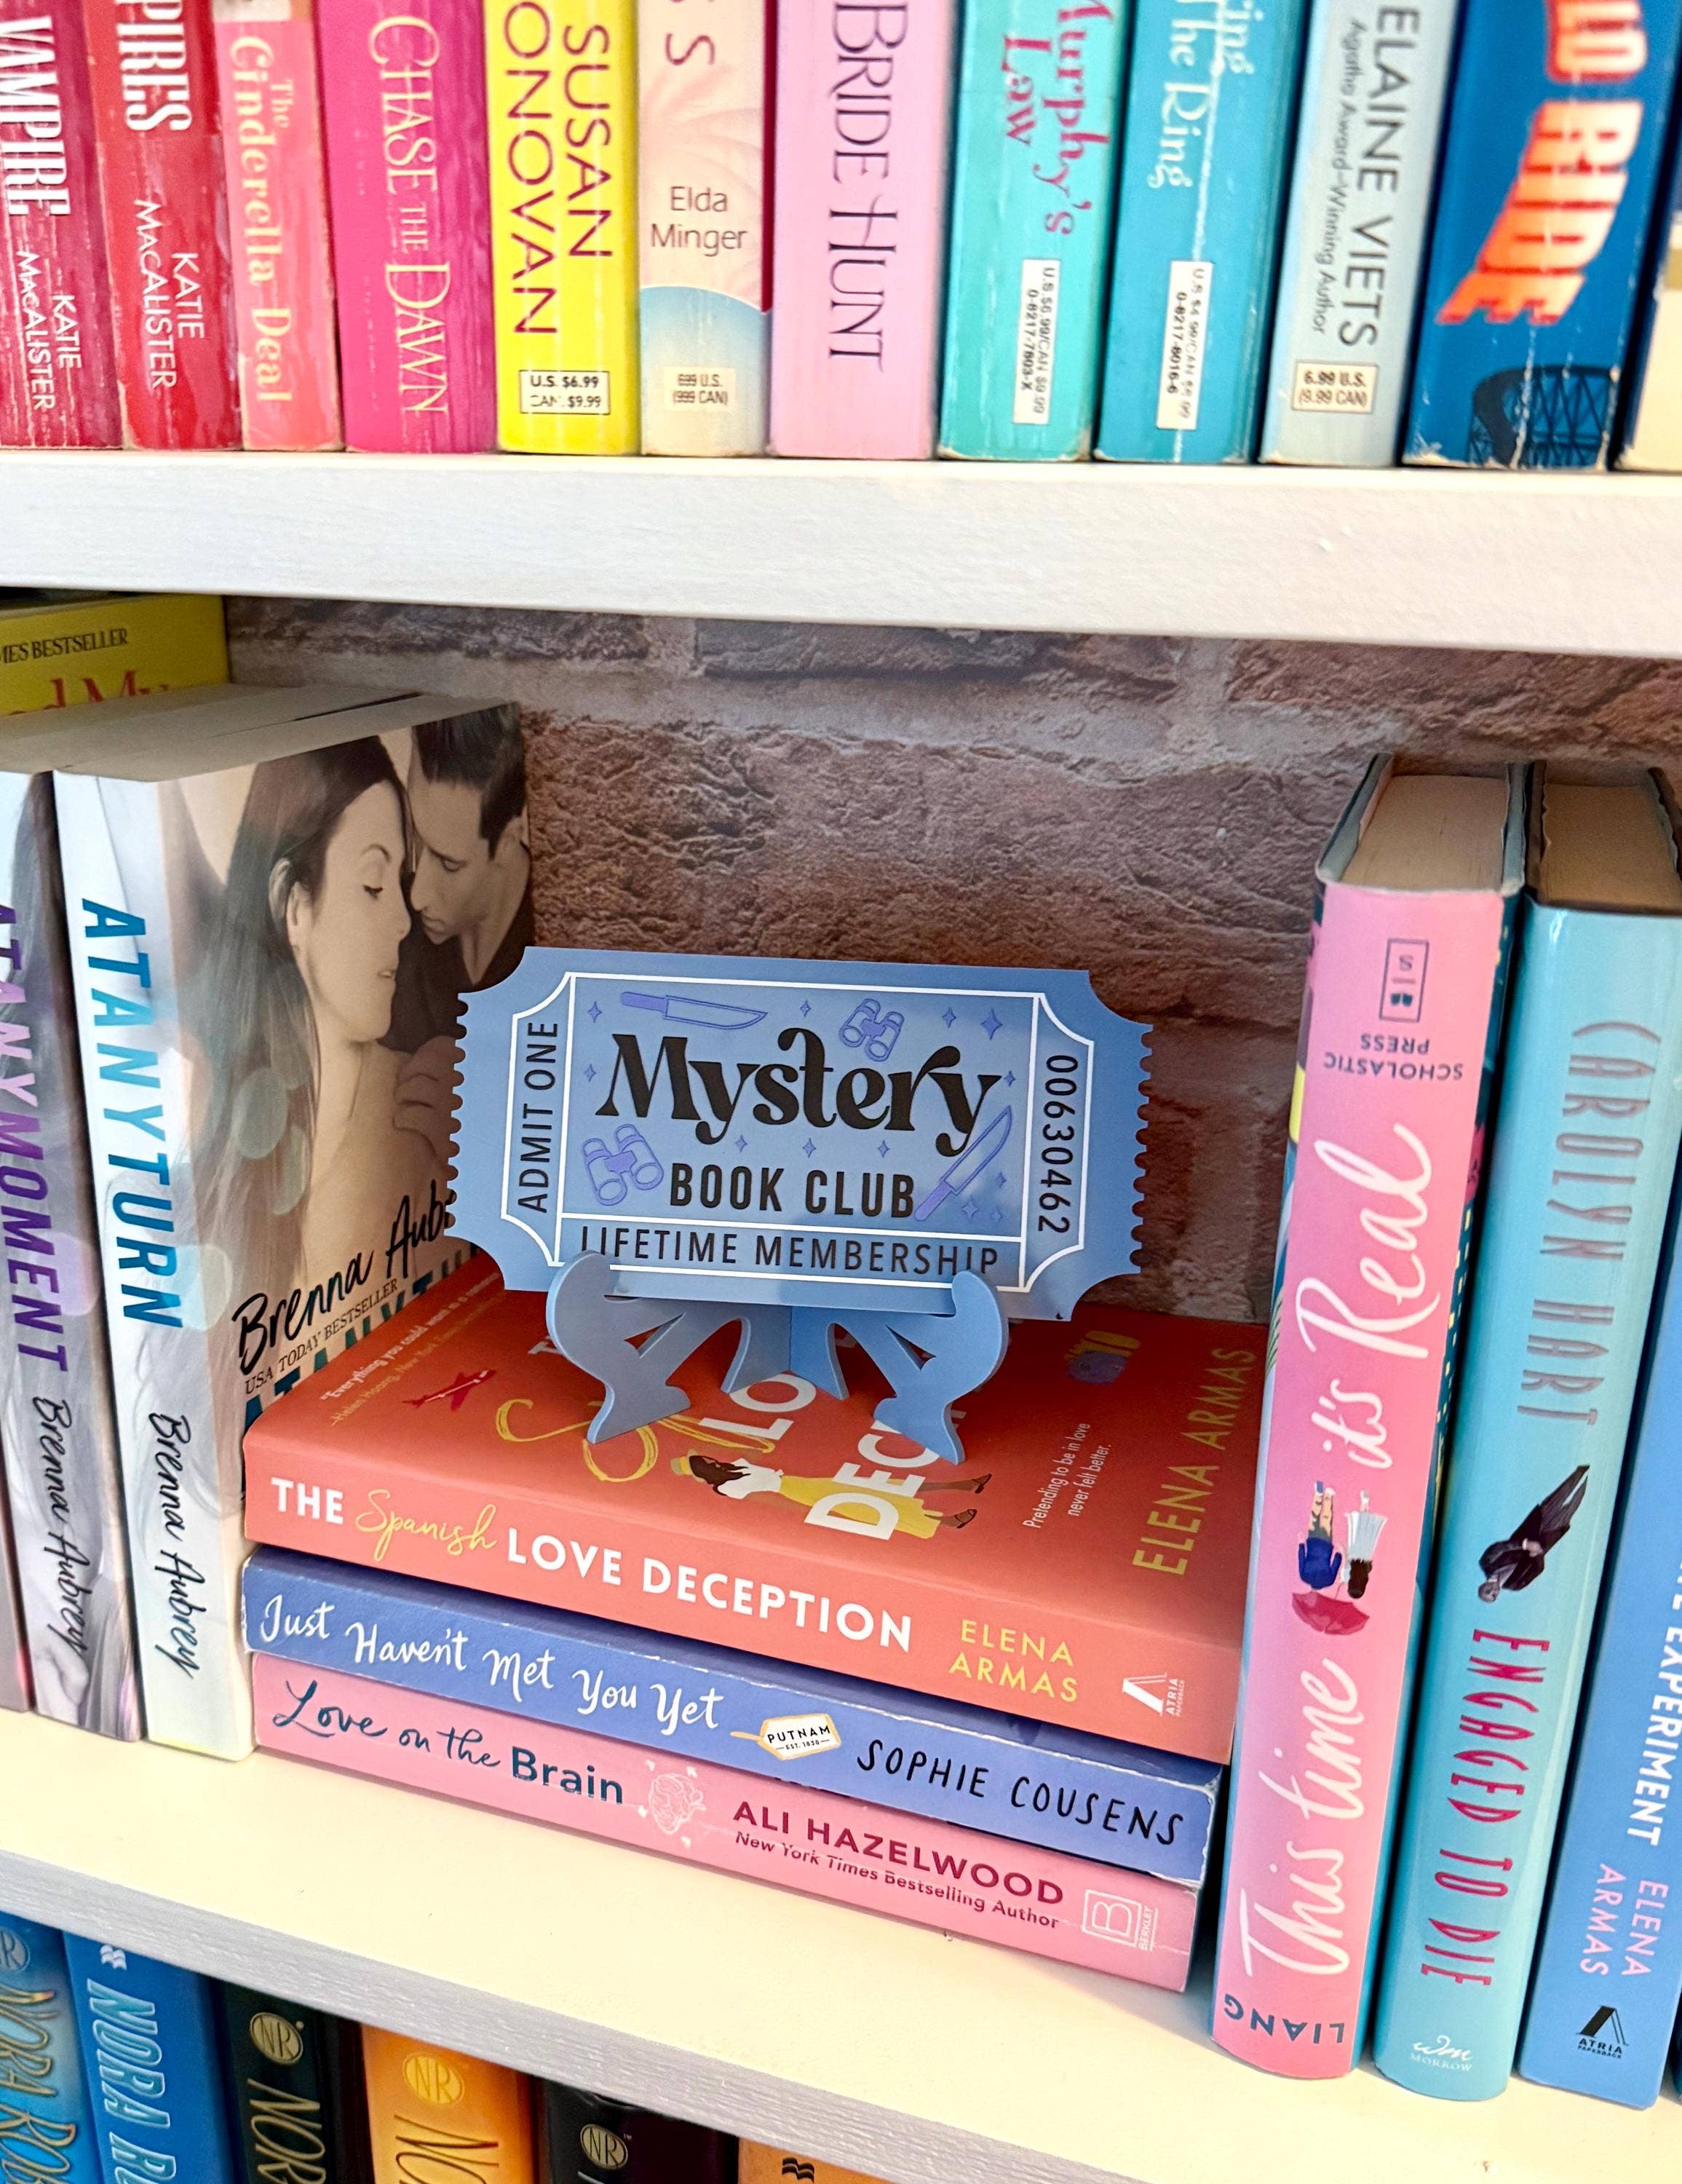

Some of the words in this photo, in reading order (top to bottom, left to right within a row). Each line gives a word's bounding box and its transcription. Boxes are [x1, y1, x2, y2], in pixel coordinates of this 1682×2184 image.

[115, 0, 193, 130] PIRES
[270, 79, 295, 128] The
[370, 15, 440, 194] CHASE
[828, 2, 908, 184] BRIDE
[1001, 35, 1053, 148] Law
[1340, 20, 1368, 96] Agatha
[1358, 7, 1421, 193] ELAINE
[0, 15, 71, 215] VAMPIRE
[230, 35, 285, 282] Cinderella
[504, 1, 558, 334] ONOVAN
[563, 24, 613, 258] SUSAN
[1146, 81, 1212, 189] Ring
[399, 207, 429, 254] THE
[649, 223, 747, 256] Minger
[669, 185, 728, 213] Elda
[1316, 104, 1358, 276] Award-Winning
[1434, 99, 1644, 325] RIDE
[52, 295, 82, 368] KATIE
[172, 252, 205, 339] KATIE
[828, 194, 899, 372] HUNT
[1312, 274, 1338, 335] Author
[1338, 215, 1395, 348] VIETS
[251, 307, 293, 401] Deal
[384, 261, 451, 414] DAWN
[561, 375, 599, 389] $6.99
[567, 395, 602, 408] $9.99
[32, 627, 128, 661] BESTSELLER
[524, 1022, 558, 1091] ONE
[595, 1026, 1003, 1158] Mystery
[1323, 1051, 1464, 1081] SCHOLASTIC
[1360, 1033, 1430, 1054] PRESS
[517, 1102, 555, 1214] ADMIT
[670, 1163, 786, 1212] BOOK
[805, 1169, 916, 1219] CLUB
[1038, 1054, 1079, 1234] 00630462
[1539, 1020, 1663, 1262] CAROLYN
[231, 1249, 375, 1376] Brenna
[385, 1179, 456, 1279] Aub
[755, 1235, 999, 1276] MEMBERSHIP
[1295, 1122, 1441, 1360] Real
[245, 1366, 274, 1395] USA
[278, 1332, 322, 1372] TODAY
[324, 1278, 400, 1341] BESTSELLER
[1517, 1298, 1616, 1426] HART
[32, 1396, 74, 1529] Brenna
[148, 1412, 191, 1542] Brenna
[1050, 1465, 1070, 1476] to
[1052, 1452, 1076, 1465] be
[1061, 1442, 1082, 1452] in
[1064, 1423, 1091, 1441] love
[1079, 1444, 1112, 1472] better.
[1132, 1464, 1221, 1575] ELENA
[1180, 1347, 1258, 1451] ARMAS
[1309, 1378, 1393, 1470] it's
[1022, 1476, 1069, 1529] Pretending
[1067, 1489, 1090, 1516] never
[1072, 1472, 1098, 1488] felt
[44, 1530, 93, 1653] Aubrey
[155, 1550, 207, 1679] Aubrey
[270, 1476, 344, 1525] THE
[355, 1488, 499, 1562] Spanish
[509, 1528, 622, 1586] LOVE
[642, 1556, 913, 1653] DECEPTION
[259, 1593, 336, 1644] Just
[345, 1620, 469, 1673] Haven't
[482, 1649, 556, 1703] Met
[572, 1669, 638, 1717] You
[649, 1683, 726, 1737] Yet
[948, 1651, 1079, 1704] ARMAS
[960, 1618, 1074, 1669] ELENA
[1165, 1677, 1180, 1717] ATRIA
[271, 1679, 389, 1738] Love
[397, 1727, 432, 1754] on
[437, 1725, 502, 1769] the
[512, 1745, 624, 1806] Brain
[767, 1725, 831, 1744] PUTNAM
[1258, 1656, 1365, 1822] time
[1445, 1628, 1551, 1825] ENGAGED
[1626, 1626, 1682, 1848] EXPERIMENT
[857, 1738, 991, 1799] SOPHIE
[1009, 1776, 1185, 1847] COUSENS
[731, 1800, 790, 1836] ALI
[806, 1819, 1066, 1907] HAZELWOOD
[734, 1830, 776, 1854] New
[780, 1842, 821, 1867] York
[825, 1854, 879, 1882] Times
[883, 1869, 986, 1912] Bestselling
[991, 1899, 1060, 1930] Author
[1433, 1848, 1514, 1898] TO
[1137, 1904, 1154, 1952] BERKLEY
[1239, 1840, 1351, 1979] This
[1420, 1916, 1501, 1987] DIE
[1579, 1862, 1627, 1977] ARMAS
[1621, 1878, 1670, 1976] ELENA
[86, 1977, 171, 2129] NORA
[1223, 1992, 1346, 2045] LIANG
[1409, 2052, 1472, 2072] MORROW
[1578, 2038, 1624, 2054] ATRIA
